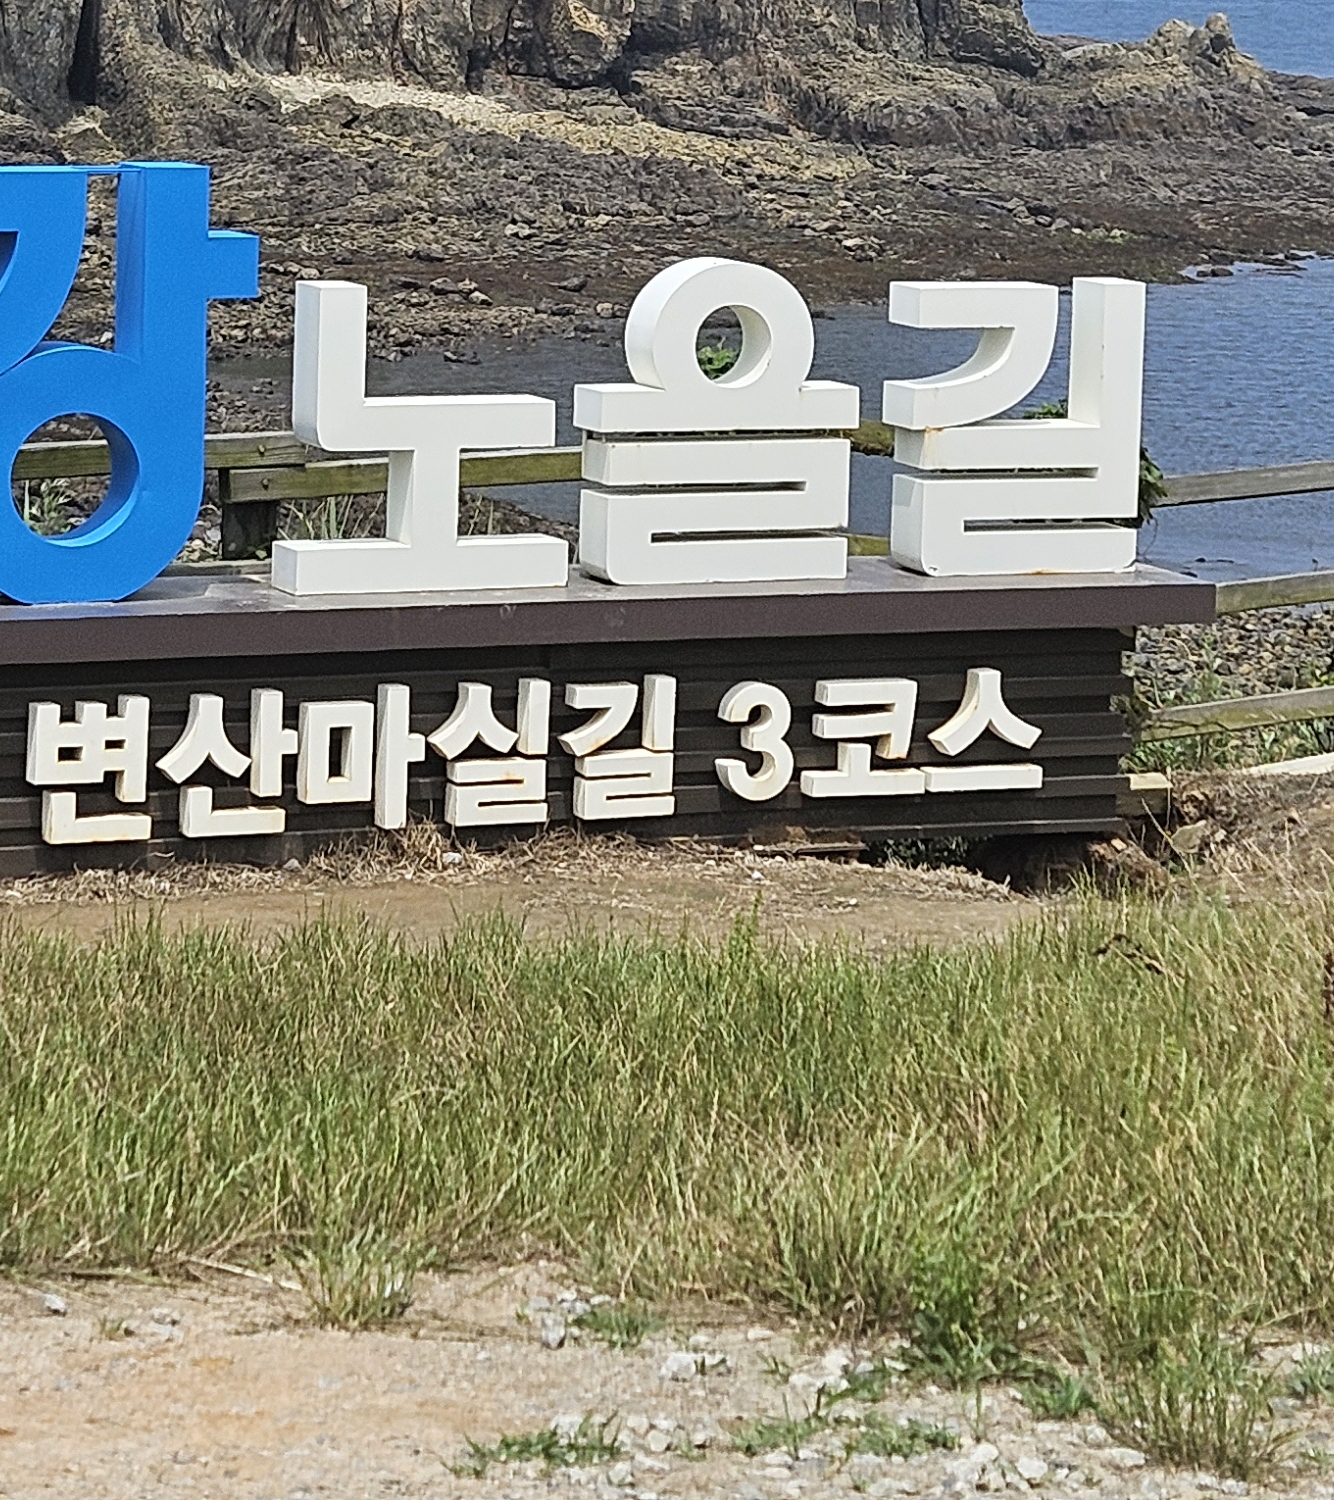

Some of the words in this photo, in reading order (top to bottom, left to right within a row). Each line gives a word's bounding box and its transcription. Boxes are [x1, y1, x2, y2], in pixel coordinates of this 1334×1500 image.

[271, 257, 1145, 597] 노을길
[26, 674, 677, 845] 변산마실길
[715, 667, 1043, 801] 3코스
